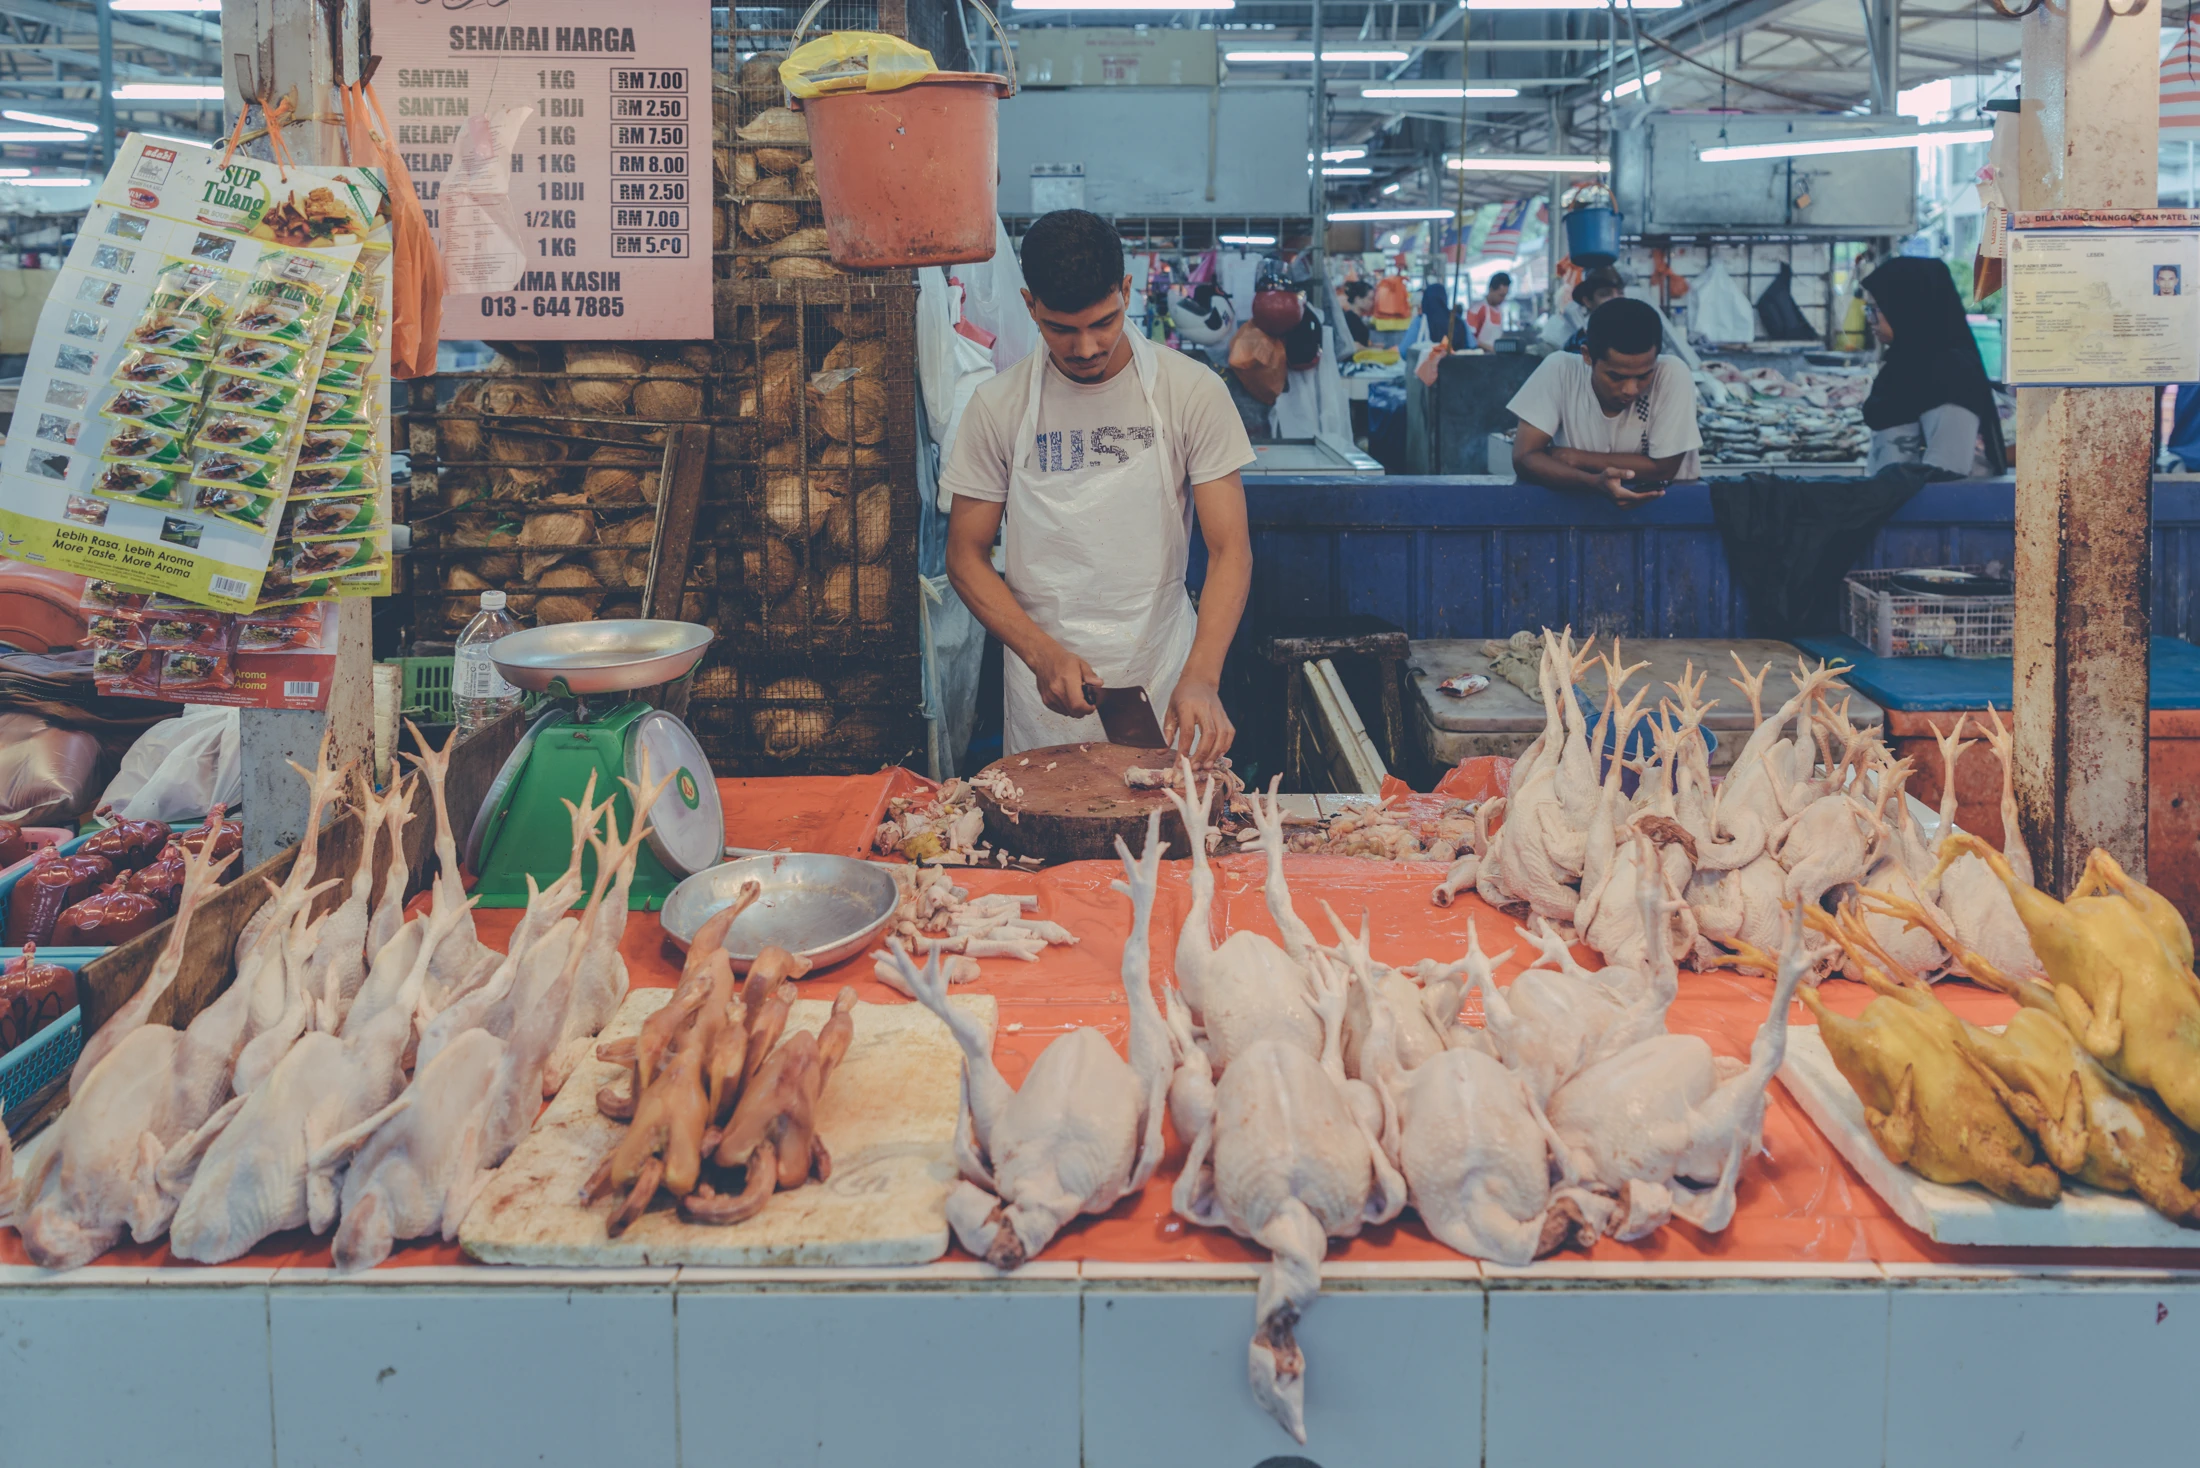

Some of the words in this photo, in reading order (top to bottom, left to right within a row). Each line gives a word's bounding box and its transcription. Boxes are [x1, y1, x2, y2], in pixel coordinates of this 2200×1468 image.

[449, 25, 549, 51] SENARAI
[556, 27, 636, 52] HARGA
[398, 69, 469, 88] SANTAN
[537, 70, 546, 89] 1
[551, 70, 575, 89] KG
[618, 72, 644, 89] RM
[648, 72, 683, 89] 7.00
[398, 98, 469, 117] SANTAN
[537, 98, 546, 117] 1
[551, 98, 584, 117] BIJI
[617, 100, 642, 116] RM
[646, 100, 681, 117] 2.50
[537, 126, 546, 145] 1
[551, 126, 576, 145] KG
[619, 127, 644, 144] RM
[648, 127, 683, 145] 7.50
[400, 153, 453, 172] KELAP
[537, 154, 546, 173] 1
[551, 154, 576, 173] KG
[620, 156, 644, 172] RM
[649, 156, 684, 173] 8.00
[220, 164, 261, 189] SUP
[202, 180, 266, 220] Tulang
[538, 182, 546, 201] 1
[552, 182, 584, 201] BIJI
[620, 184, 645, 200] RM
[649, 183, 684, 200] 2.50
[524, 211, 550, 227] 1/2
[552, 209, 576, 228] KG
[617, 210, 642, 226] RM
[646, 211, 680, 227] 7.00
[538, 238, 546, 256] 1
[552, 238, 576, 256] KG
[617, 236, 641, 253] RM
[561, 271, 620, 291] KASIH
[481, 296, 516, 317] 013
[533, 296, 571, 317] 644
[575, 296, 624, 317] 7885
[56, 528, 88, 543] Lebih
[91, 535, 121, 551] Rasa,
[125, 543, 155, 559] Lebih
[158, 551, 194, 568] Aroma
[52, 539, 84, 553] More
[87, 547, 118, 562] Taste,
[121, 554, 151, 569] More
[154, 561, 191, 578] Aroma
[235, 668, 267, 679] Aroma
[234, 680, 267, 690] Aroma
